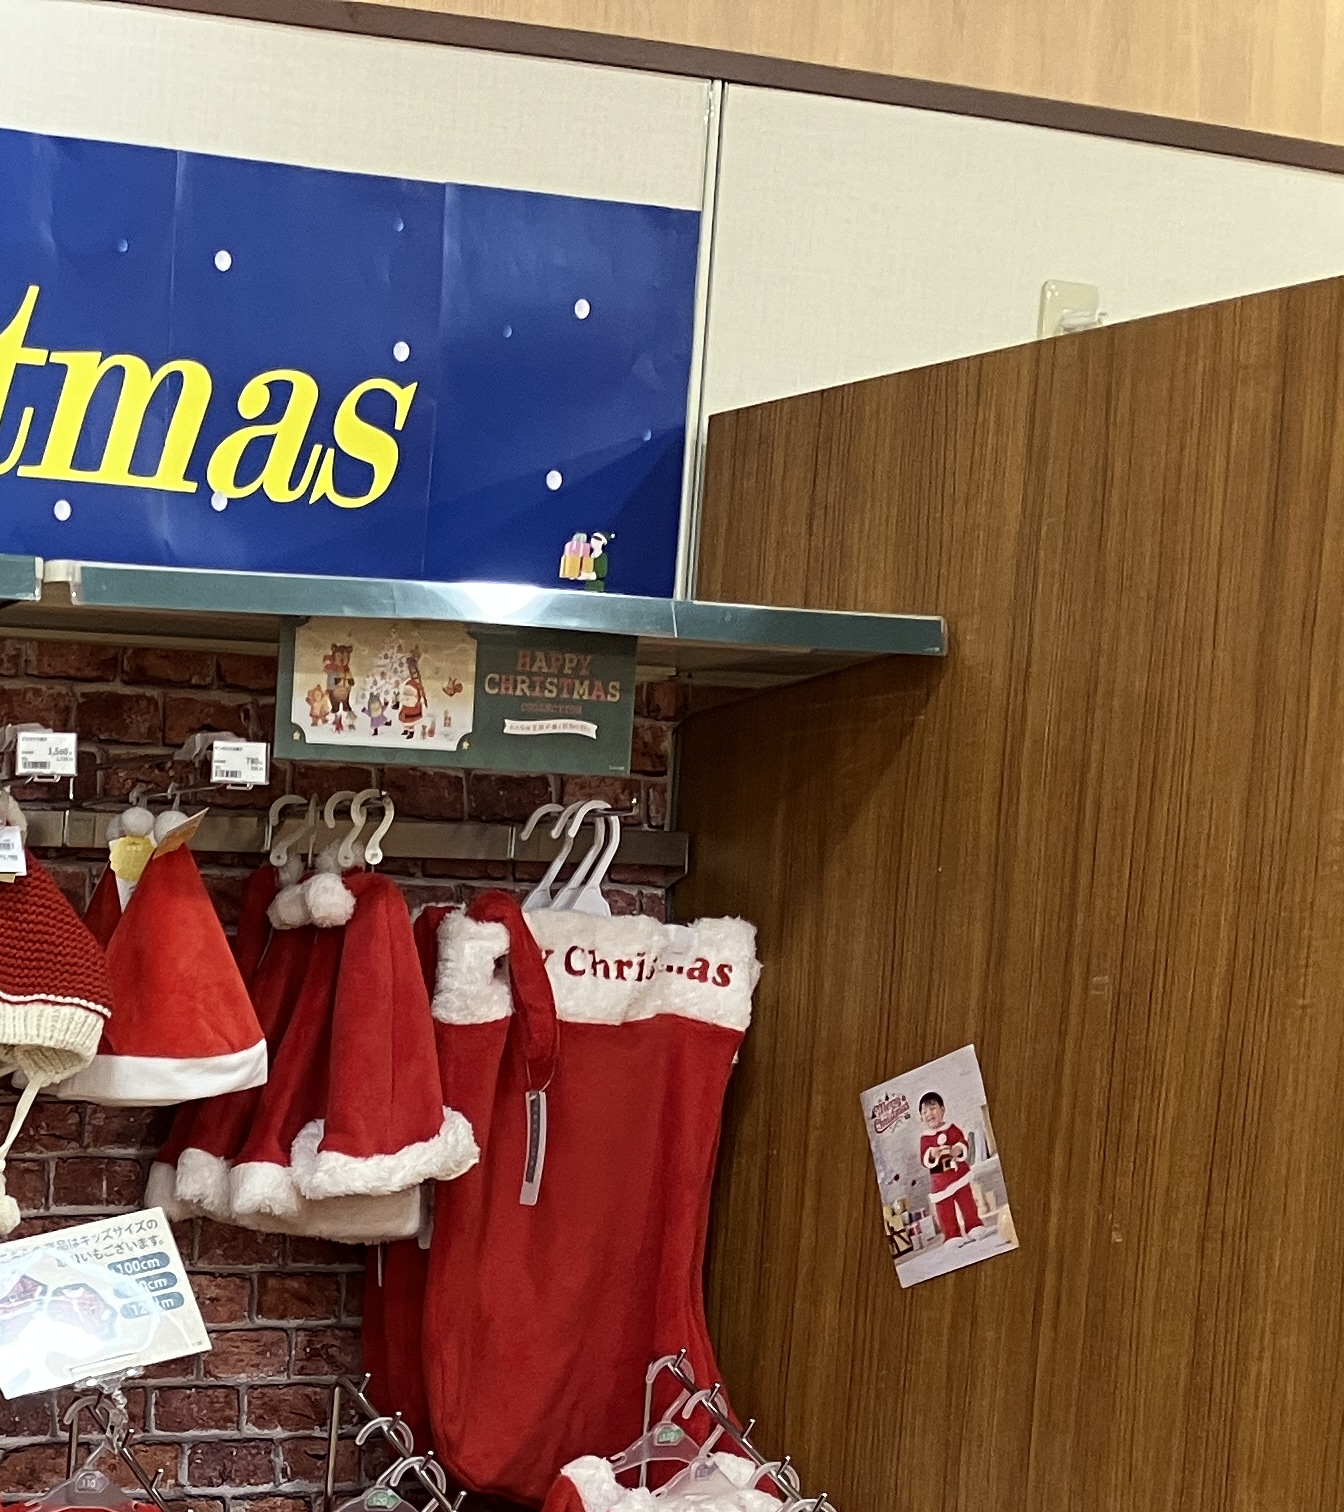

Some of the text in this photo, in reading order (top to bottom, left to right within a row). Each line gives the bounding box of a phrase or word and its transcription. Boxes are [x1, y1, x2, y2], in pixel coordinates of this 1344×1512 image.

[516, 650, 592, 676] HAPPY
[485, 673, 620, 702] CHRISTMAS
[116, 1258, 161, 1275] 100cm
[82, 1478, 96, 1488] 110
